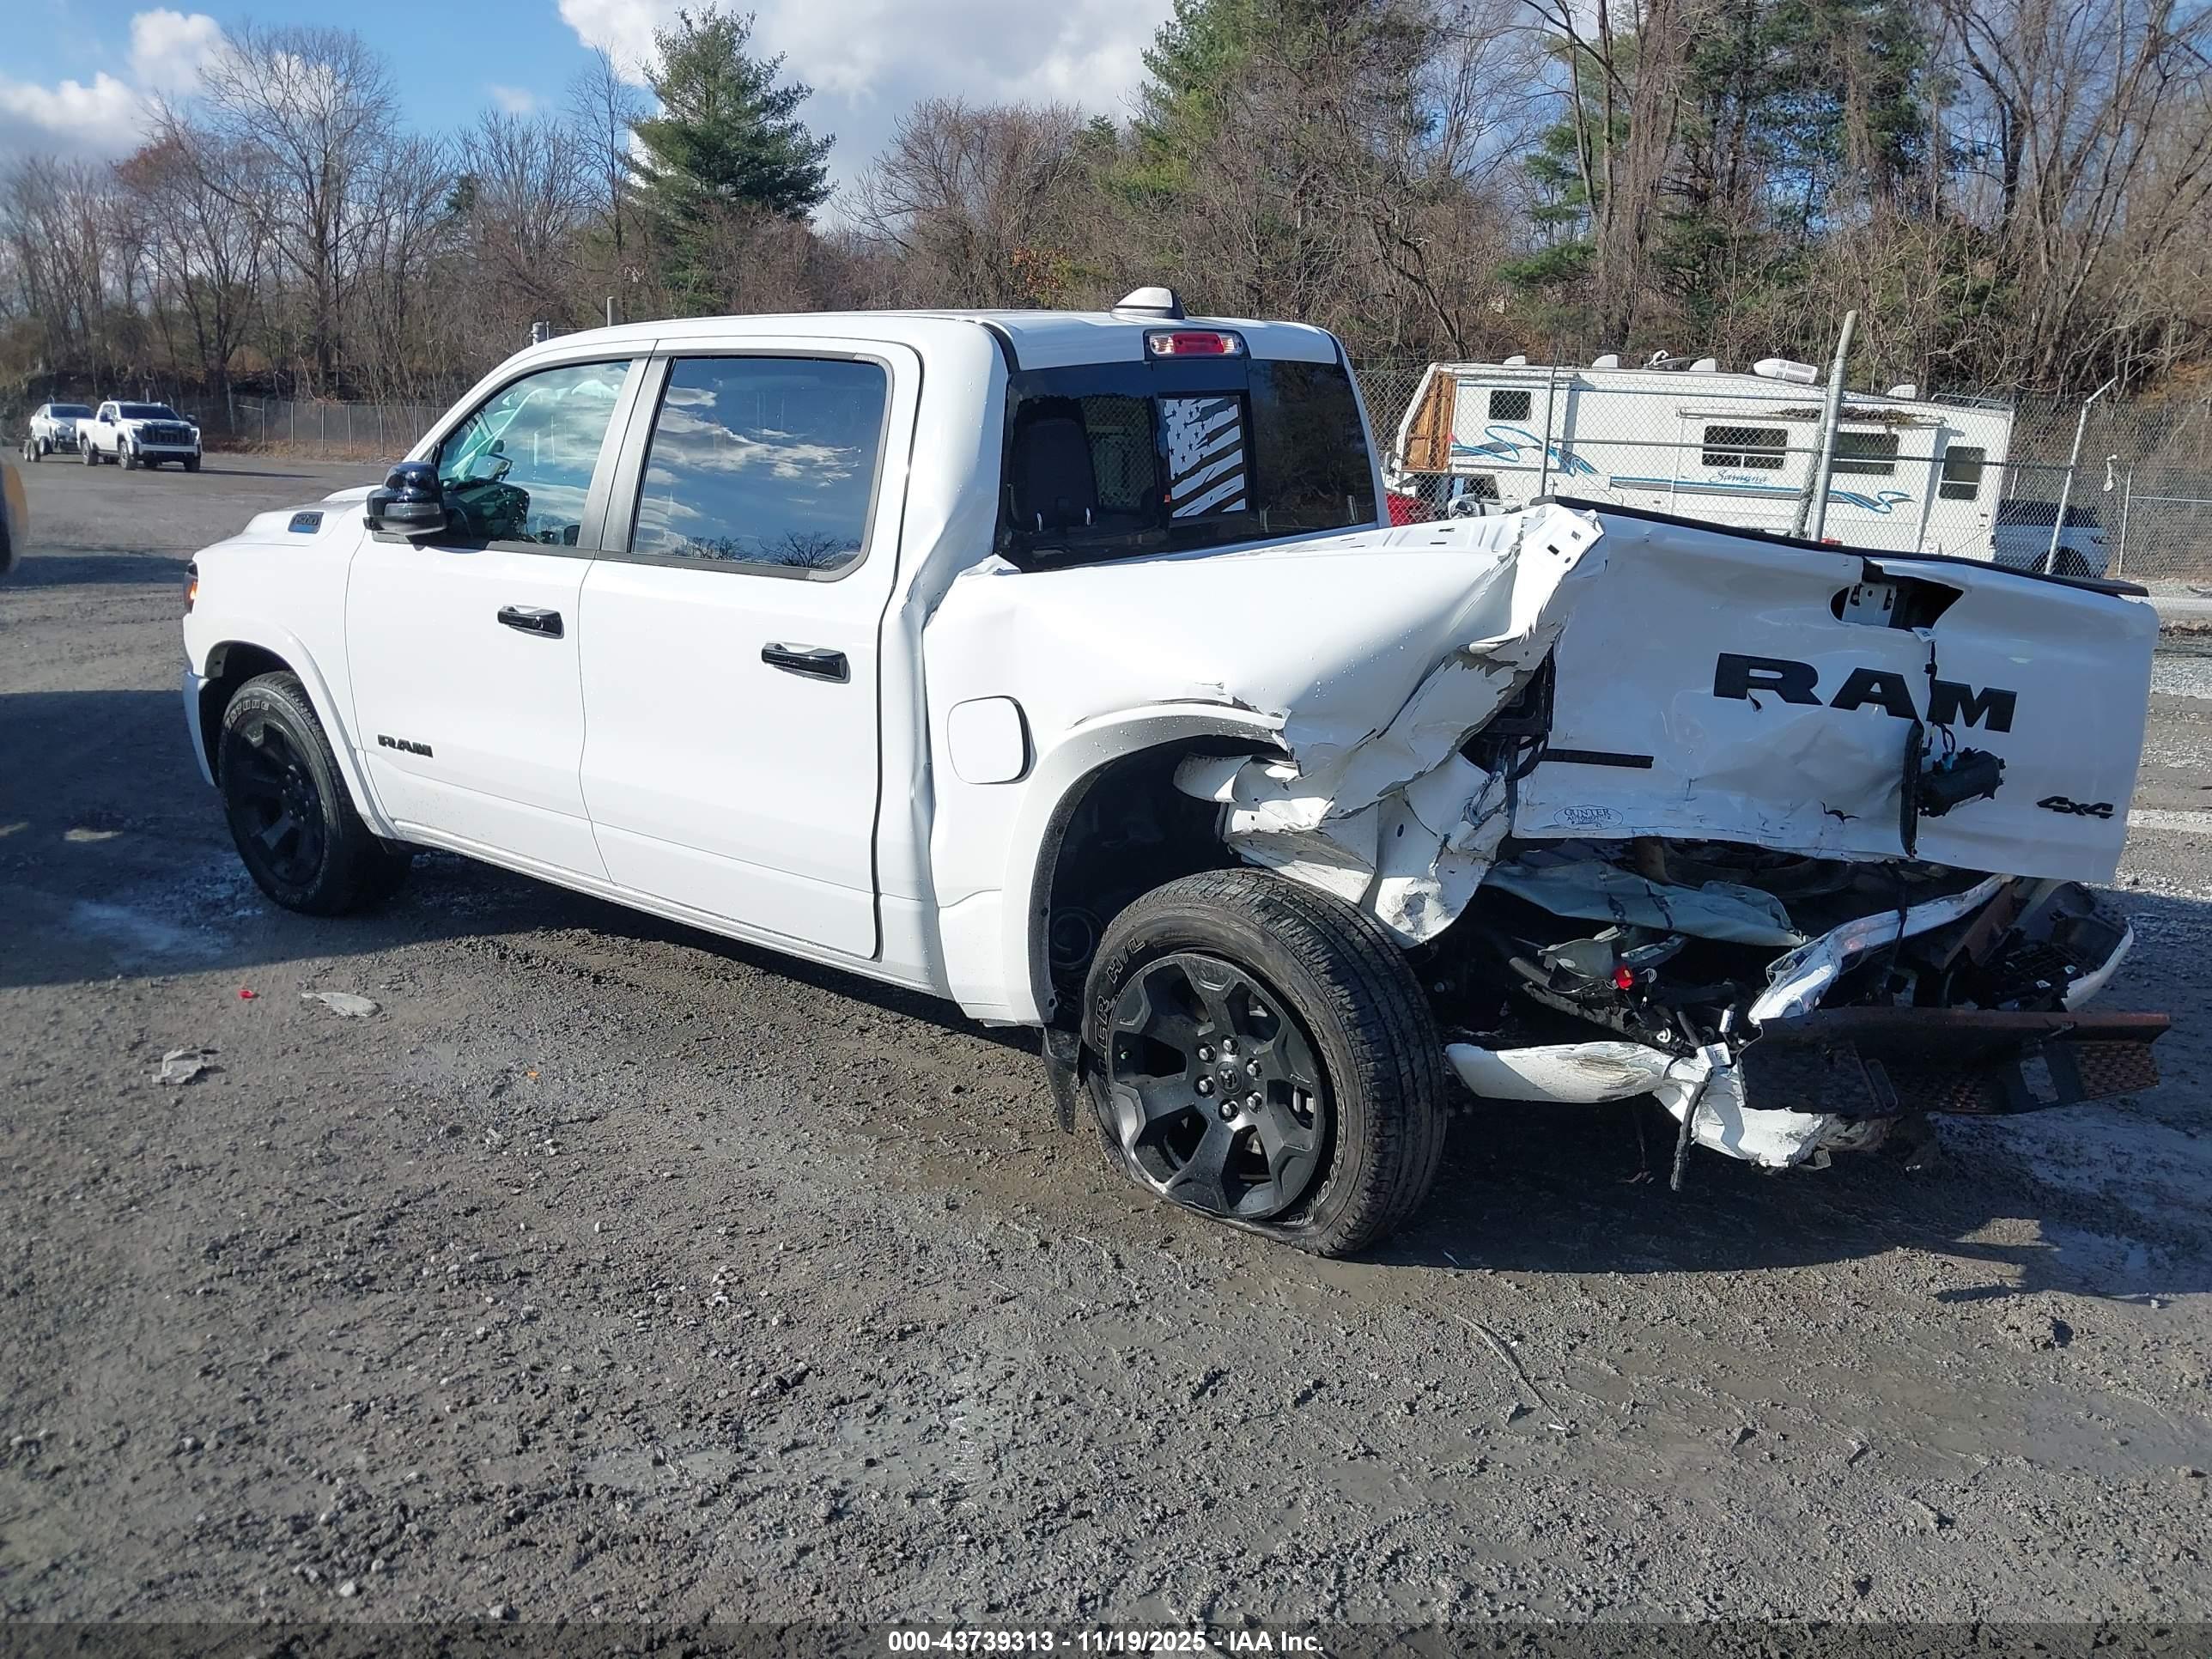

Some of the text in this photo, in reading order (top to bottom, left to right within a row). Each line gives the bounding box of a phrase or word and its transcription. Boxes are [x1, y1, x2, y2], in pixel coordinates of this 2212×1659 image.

[1713, 652, 2018, 733] RAM
[377, 733, 434, 759] RAM
[1564, 808, 1612, 817] GUNTER
[1106, 937, 1146, 985] H/L
